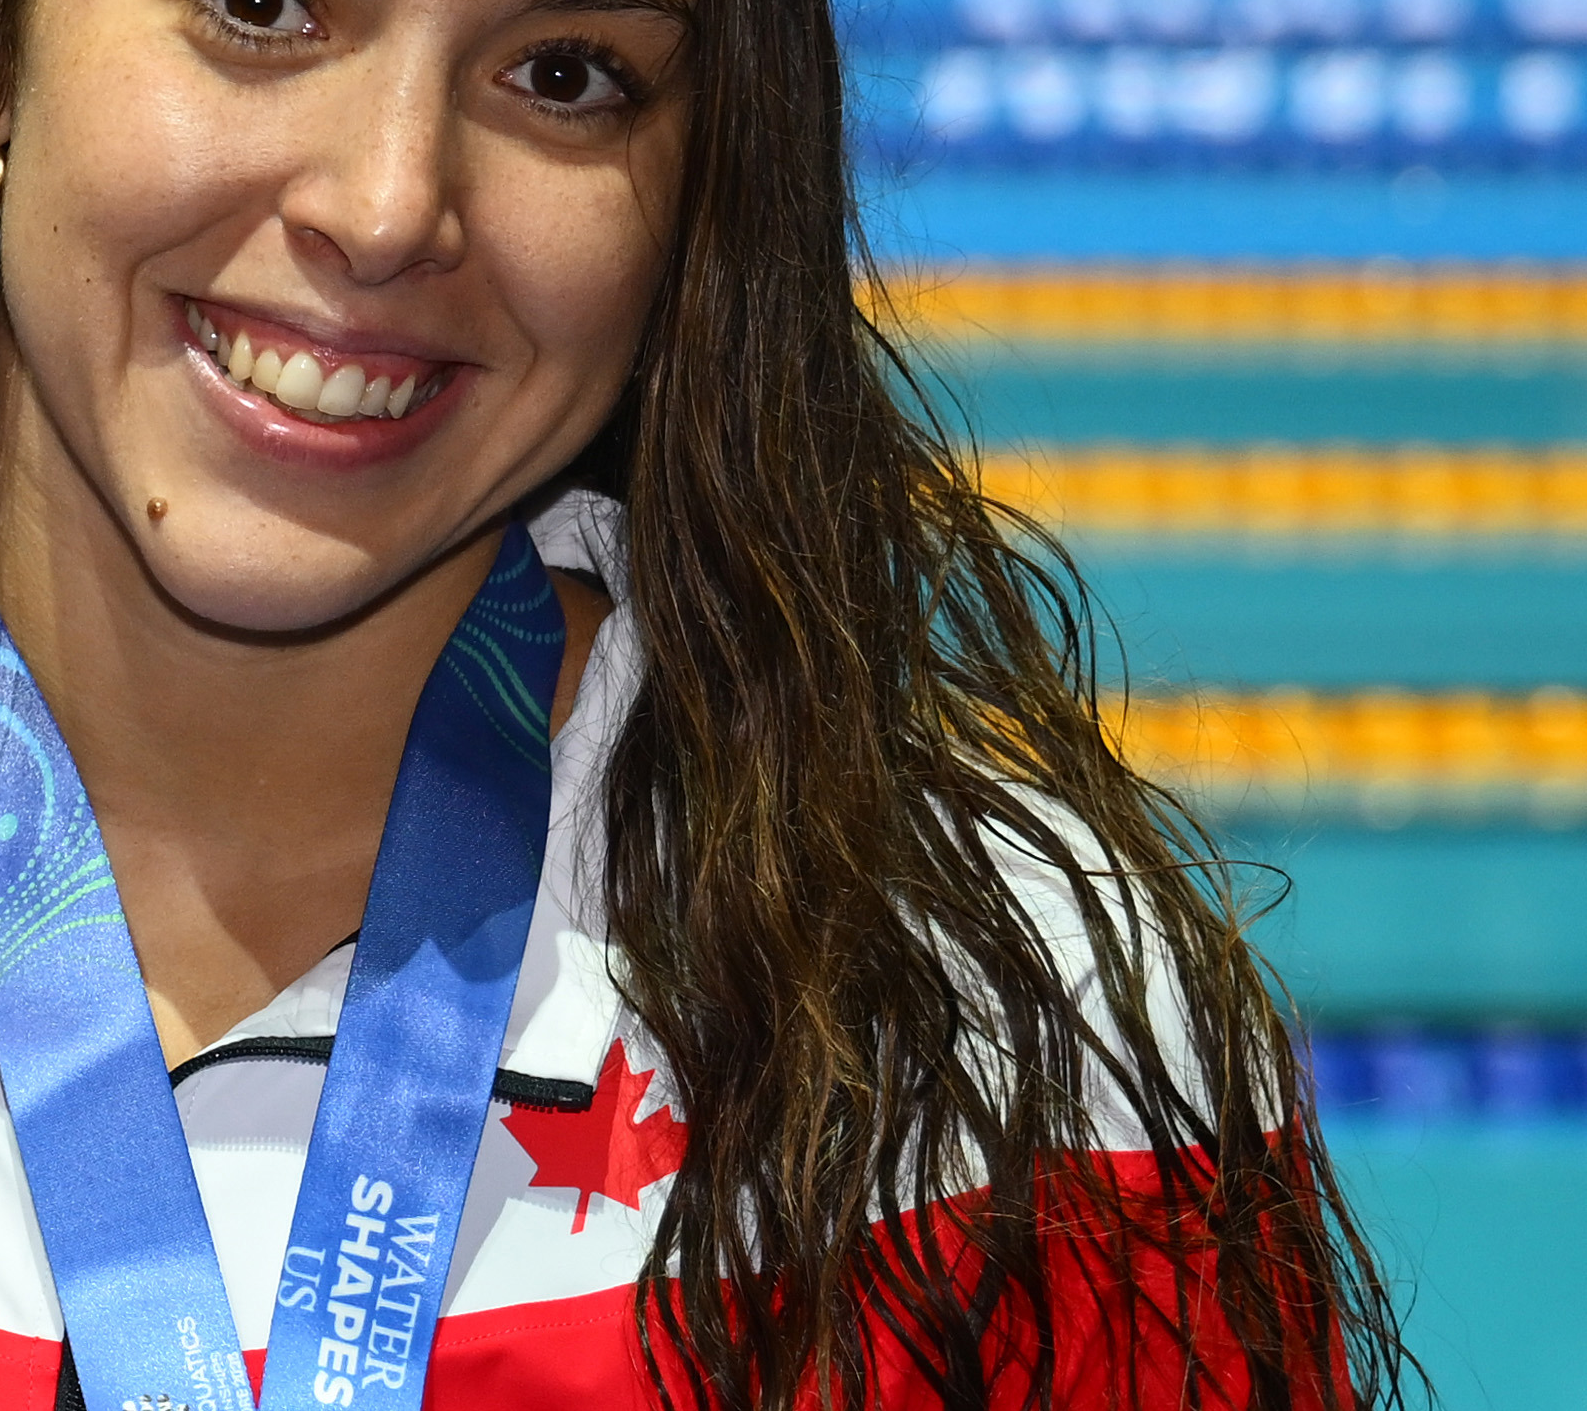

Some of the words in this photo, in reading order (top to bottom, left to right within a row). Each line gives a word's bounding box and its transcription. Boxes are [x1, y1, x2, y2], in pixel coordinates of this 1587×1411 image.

[277, 1246, 327, 1313] US
[313, 1174, 393, 1408] SHAPES
[362, 1213, 441, 1390] WATER
